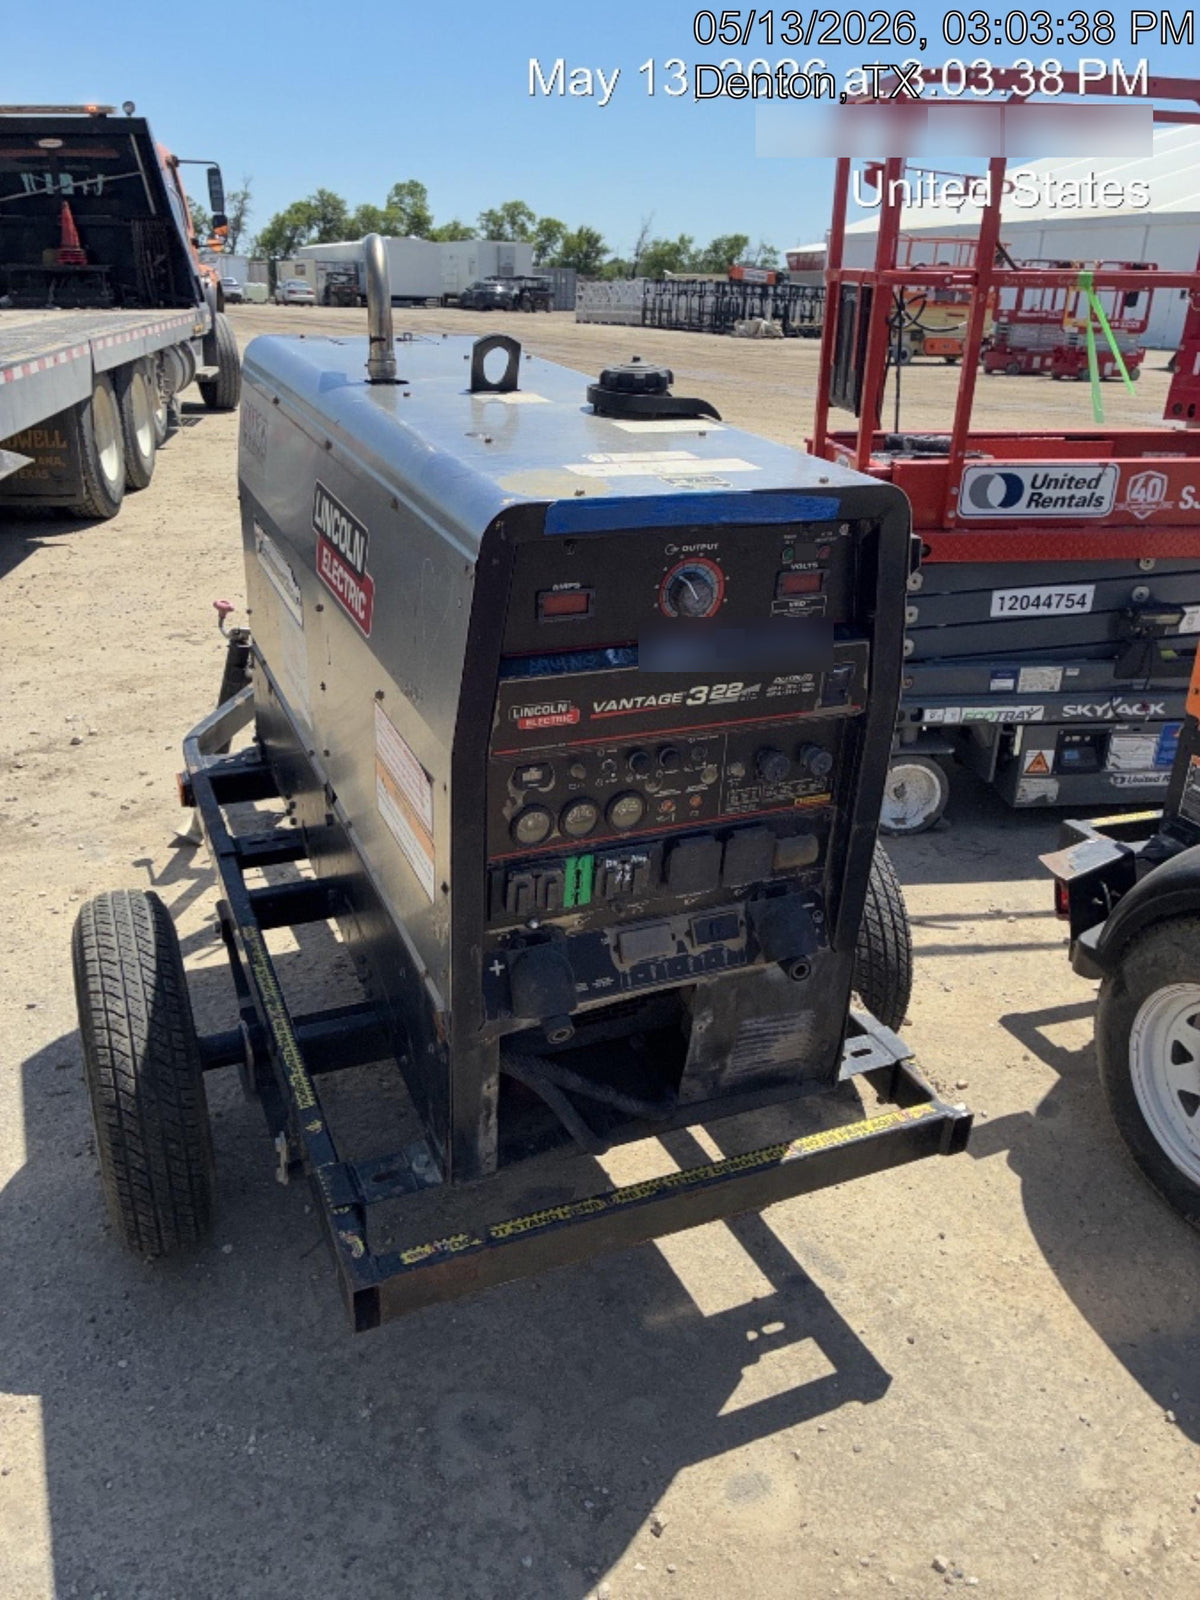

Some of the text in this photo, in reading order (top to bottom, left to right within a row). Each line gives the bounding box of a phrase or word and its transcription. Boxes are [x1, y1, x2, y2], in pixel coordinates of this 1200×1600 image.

[1030, 473, 1102, 490] United
[1131, 476, 1161, 502] 40
[1027, 492, 1105, 509] Rentals
[315, 490, 364, 573] LINCOLN
[683, 543, 719, 551] OUTPUT
[322, 548, 366, 620] ELECTRIC
[998, 593, 1087, 611] 12044754
[593, 692, 683, 713] VANTAGE
[686, 681, 744, 705] 322
[513, 703, 567, 719] LINCOLN
[1062, 697, 1165, 719] SKYJACK
[525, 714, 573, 727] ELECTRIC
